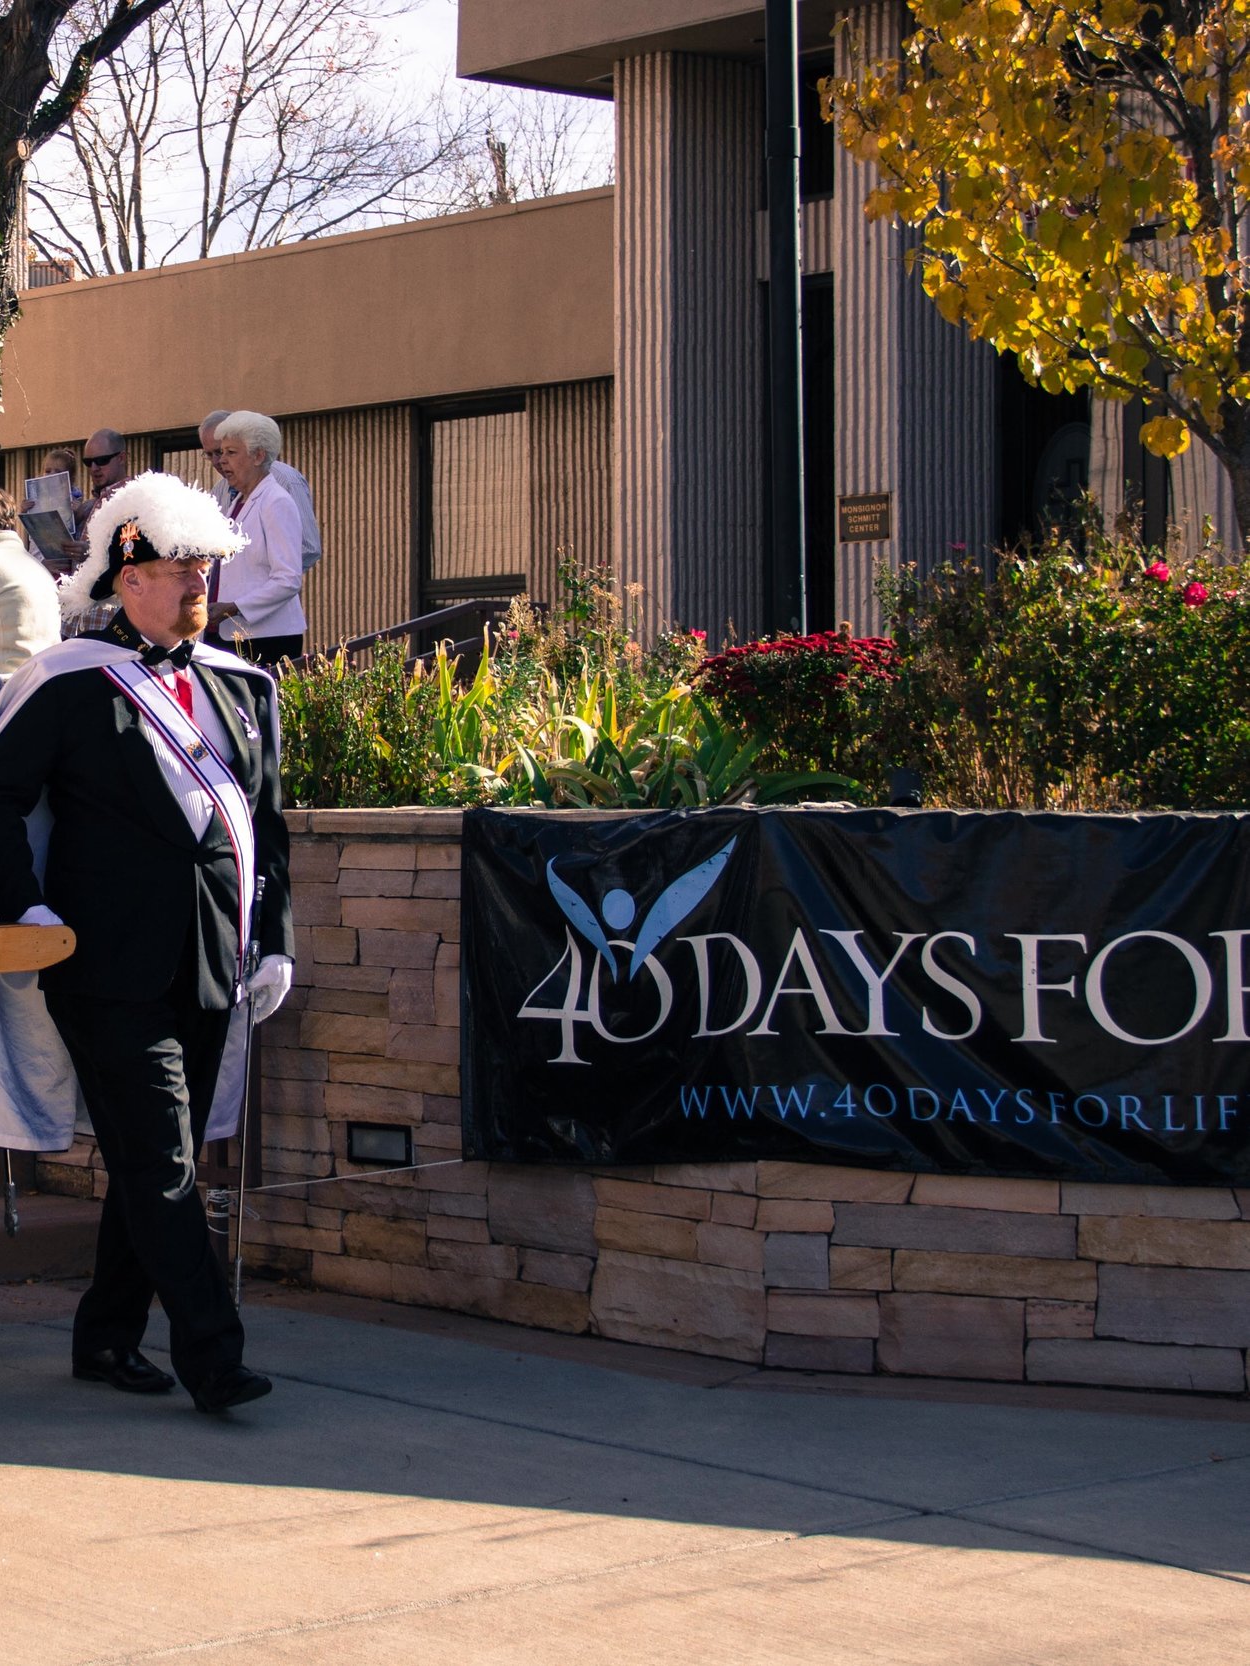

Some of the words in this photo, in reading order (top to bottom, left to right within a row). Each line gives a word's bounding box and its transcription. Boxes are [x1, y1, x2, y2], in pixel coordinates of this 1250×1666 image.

[841, 503, 887, 514] MONSIGNOR
[847, 514, 880, 523] SCHMITT
[849, 524, 879, 533] CENTER
[517, 925, 673, 1065] 40
[676, 926, 982, 1041] DAYS
[681, 1083, 1250, 1131] WWW.40DAYSFORLIF
